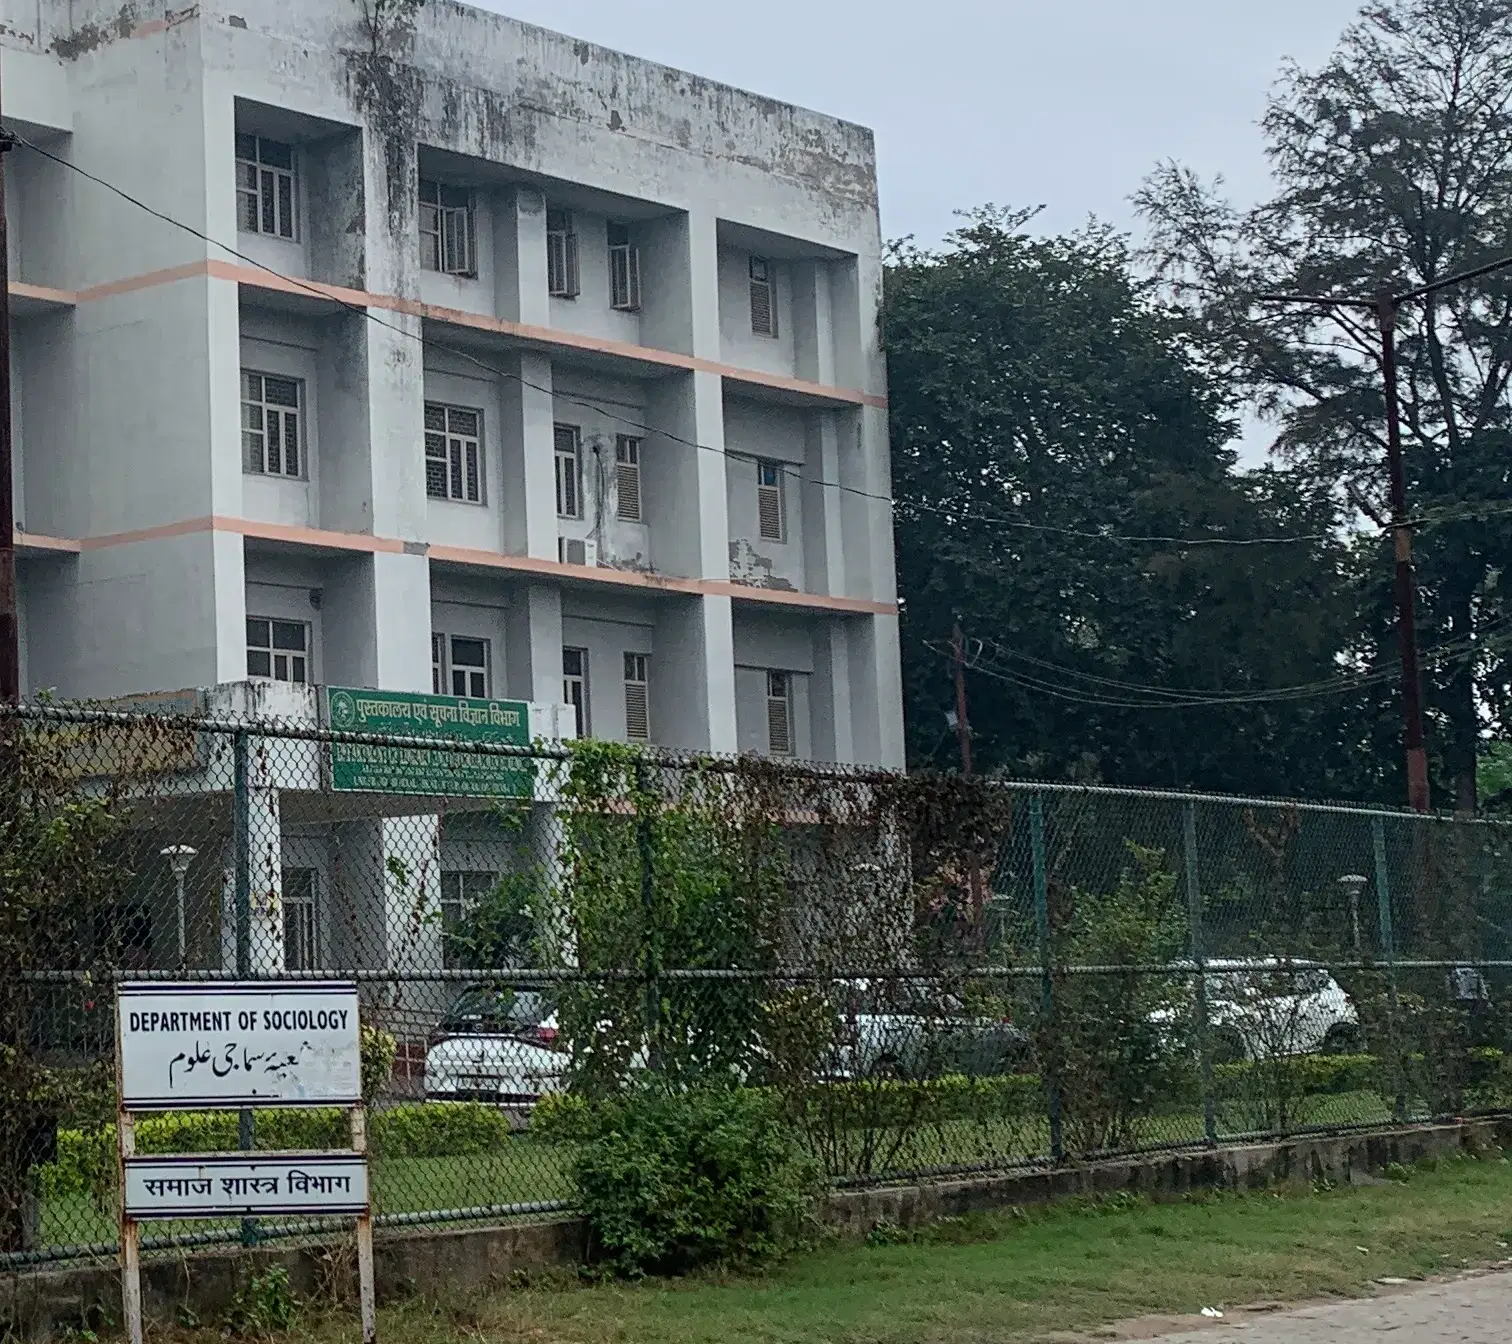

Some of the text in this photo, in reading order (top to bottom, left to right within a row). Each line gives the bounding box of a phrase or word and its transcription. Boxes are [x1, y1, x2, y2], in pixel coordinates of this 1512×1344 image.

[356, 699, 411, 723] पुस्तकालय
[130, 1010, 348, 1032] DEPARTMENT OF SOCIOLOGY
[143, 1169, 351, 1197] समाज शास्त्र विभाग
